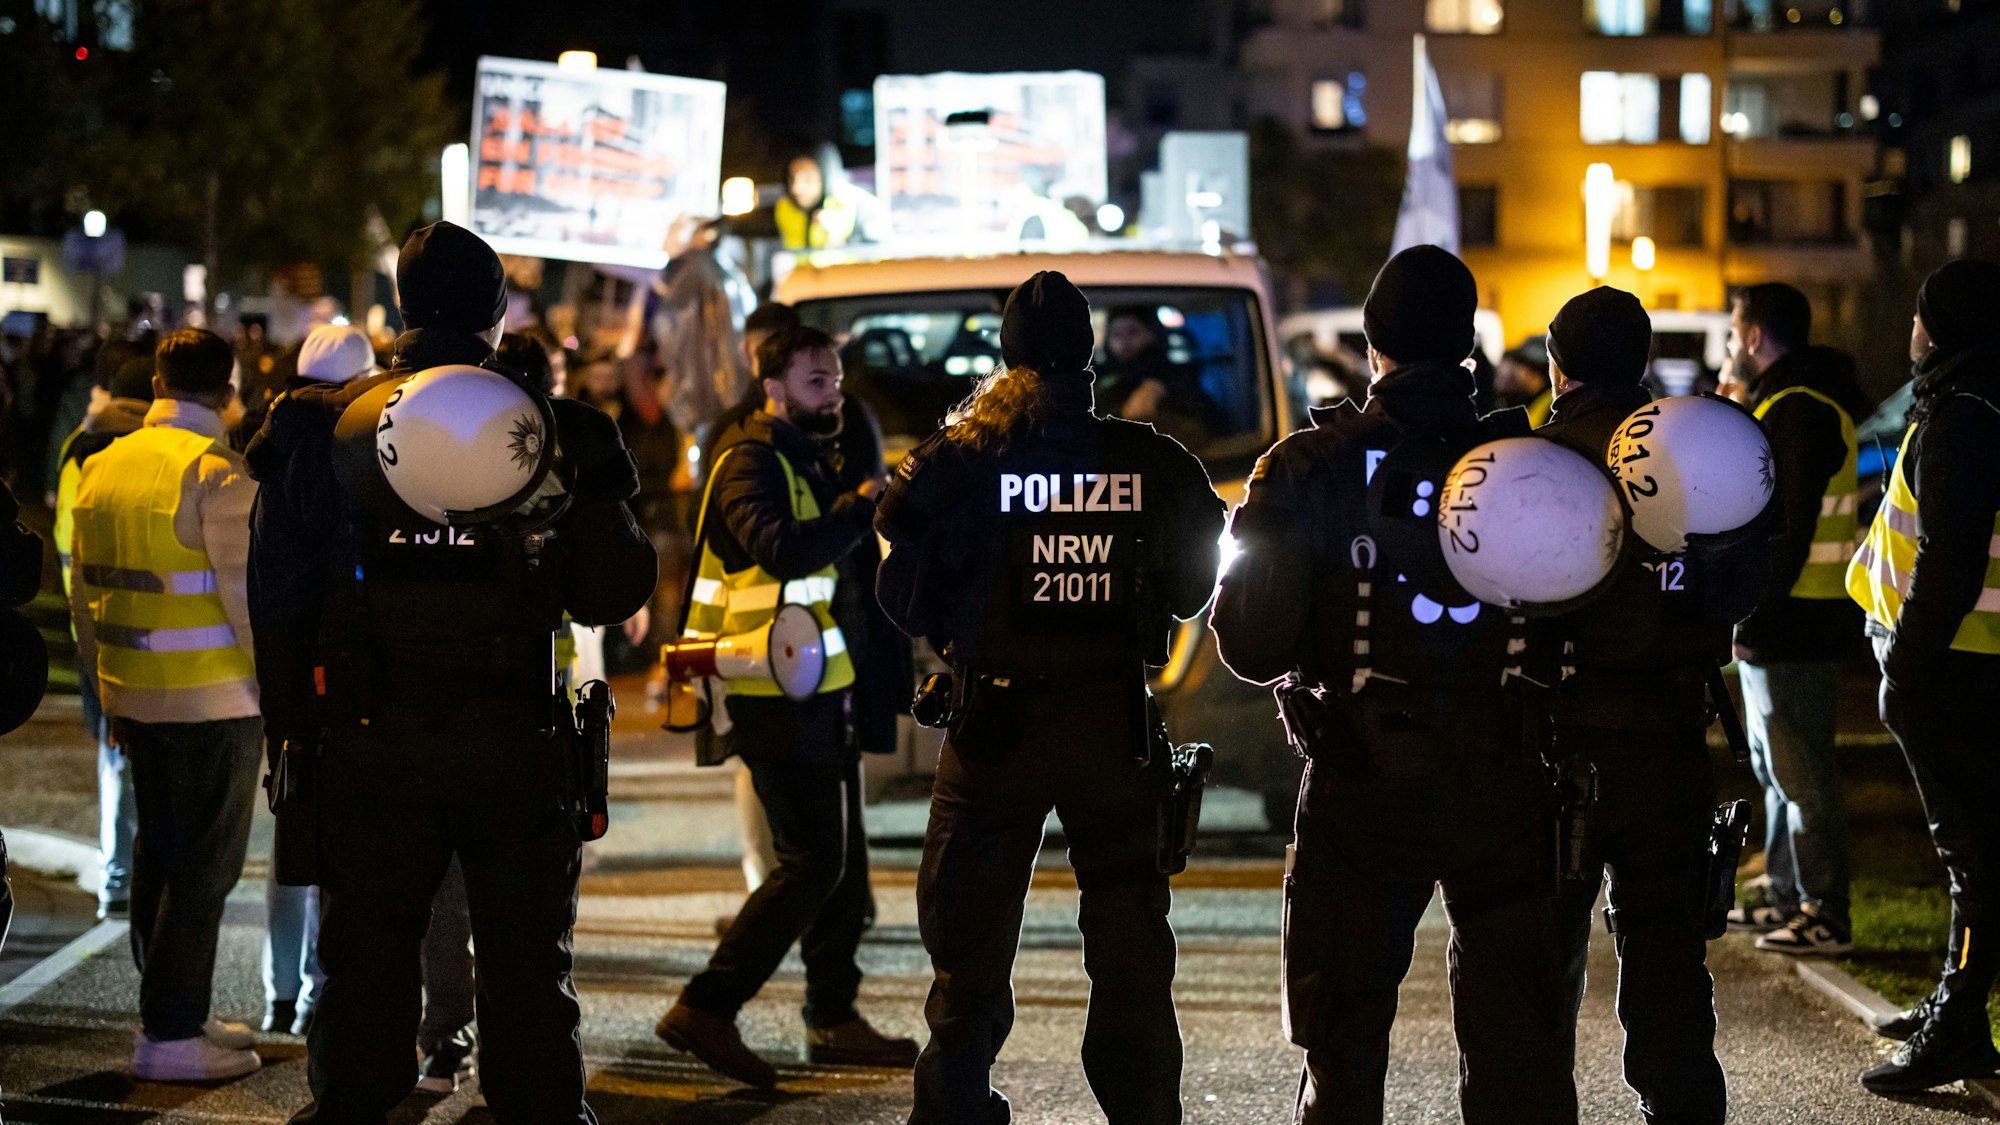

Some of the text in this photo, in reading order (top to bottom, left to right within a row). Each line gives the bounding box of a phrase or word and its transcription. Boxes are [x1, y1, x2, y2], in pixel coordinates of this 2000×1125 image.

[1622, 406, 1661, 502] 10-1-2
[1000, 473, 1142, 513] POLIZEI
[1450, 452, 1495, 553] 10-1-2
[1032, 534, 1114, 564] NRW
[1033, 571, 1111, 602] 21011
[1641, 561, 1685, 591] 12
